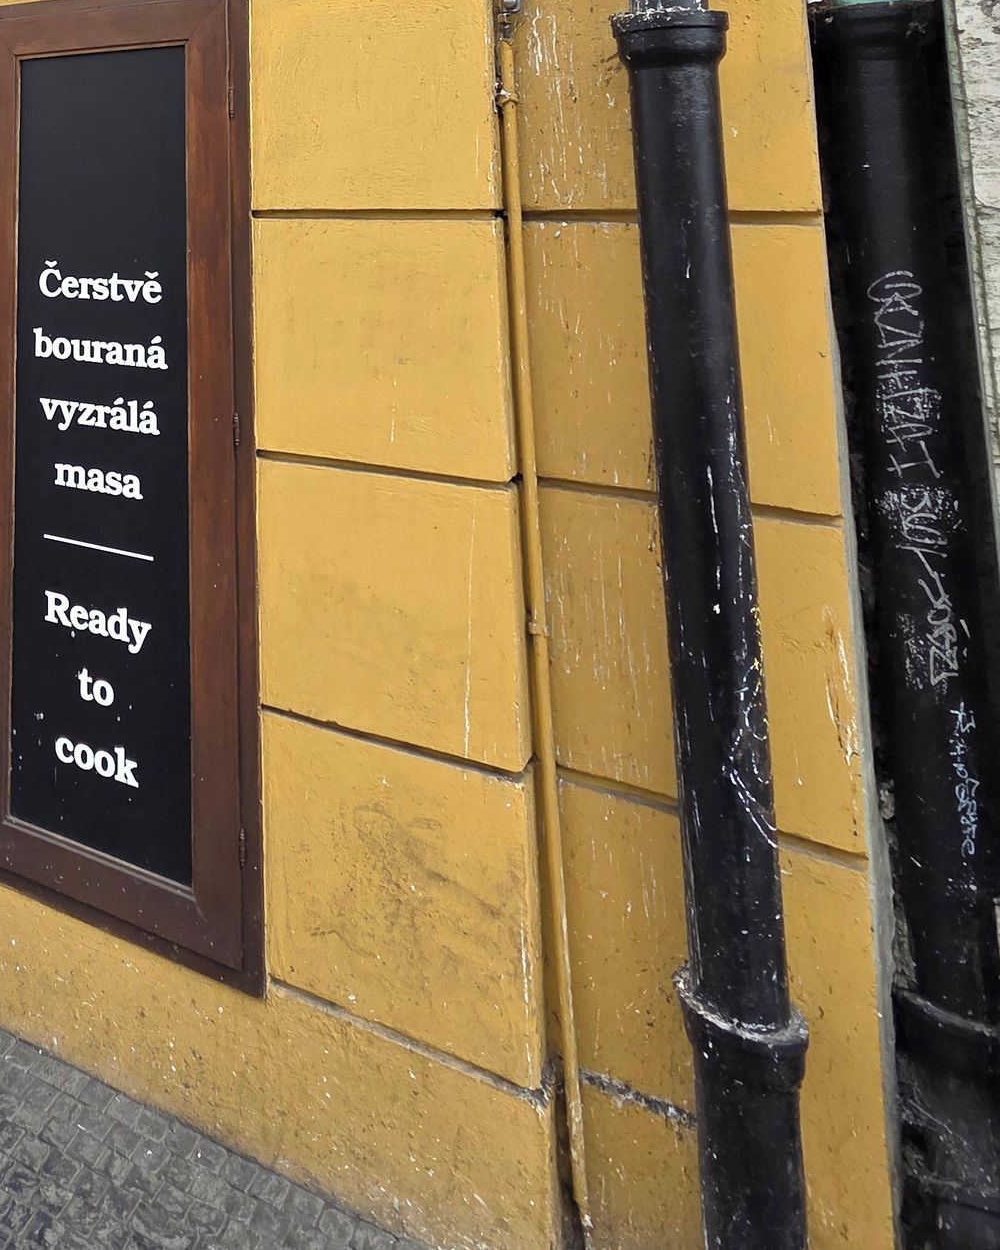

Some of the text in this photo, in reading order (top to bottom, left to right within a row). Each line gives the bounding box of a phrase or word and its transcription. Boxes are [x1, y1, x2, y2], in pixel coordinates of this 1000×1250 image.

[38, 260, 163, 304] Čerstvě
[32, 327, 169, 370] bouraná
[39, 395, 161, 436] vyzrálá
[53, 462, 144, 500] masa
[44, 589, 153, 654] Ready
[77, 667, 115, 707] to
[54, 735, 140, 789] cook
